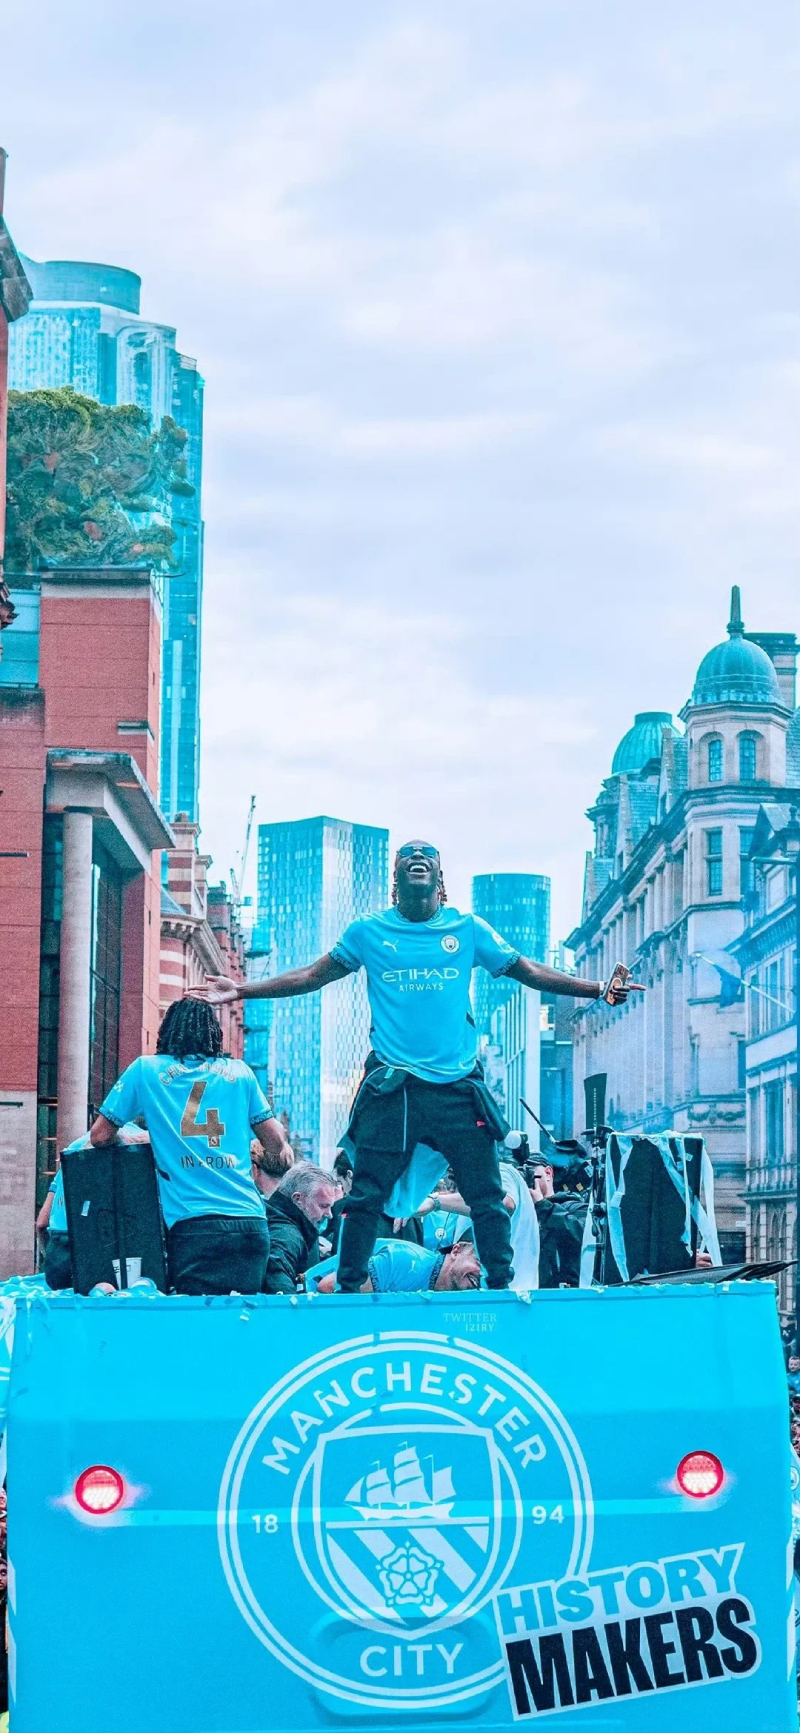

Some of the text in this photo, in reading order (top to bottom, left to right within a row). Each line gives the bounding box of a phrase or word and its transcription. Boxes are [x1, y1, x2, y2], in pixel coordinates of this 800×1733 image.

[382, 967, 460, 983] ETIHAD
[399, 982, 444, 992] AIRWAYS
[180, 1081, 226, 1148] 4
[181, 1155, 194, 1168] IN
[206, 1156, 236, 1169] ROW
[262, 1361, 547, 1476] MANCHESTER
[251, 1514, 279, 1533] 18
[531, 1505, 565, 1525] 94
[497, 1548, 740, 1634] HISTORY
[360, 1643, 464, 1677] CITY
[505, 1598, 758, 1716] MAKERS
